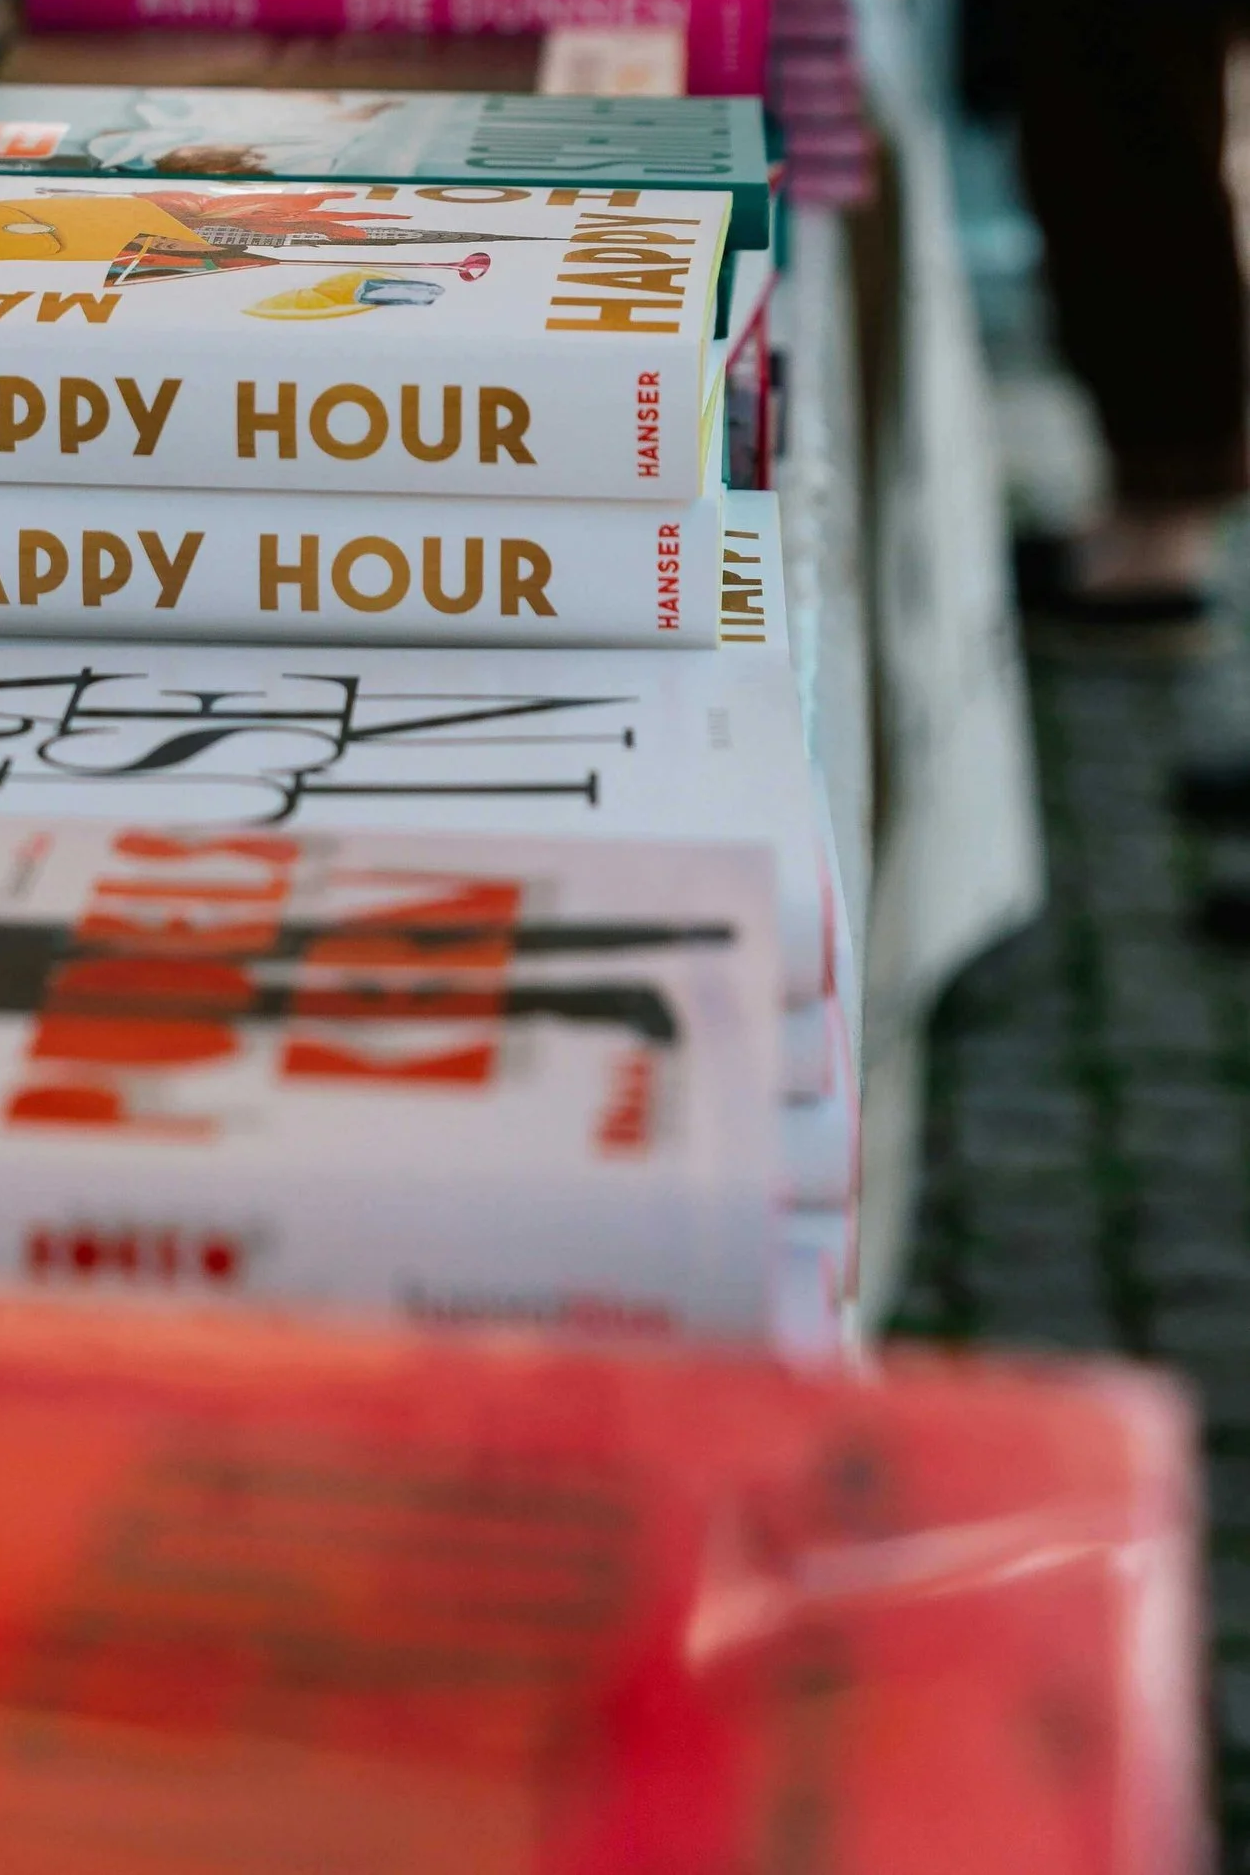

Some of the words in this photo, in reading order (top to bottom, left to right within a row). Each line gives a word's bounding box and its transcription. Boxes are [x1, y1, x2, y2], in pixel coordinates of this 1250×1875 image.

[545, 212, 701, 334] HAPPY
[236, 380, 538, 467] HOUR
[637, 369, 662, 480] HANSER
[258, 532, 559, 618] HOUR
[656, 522, 681, 631] HANSER
